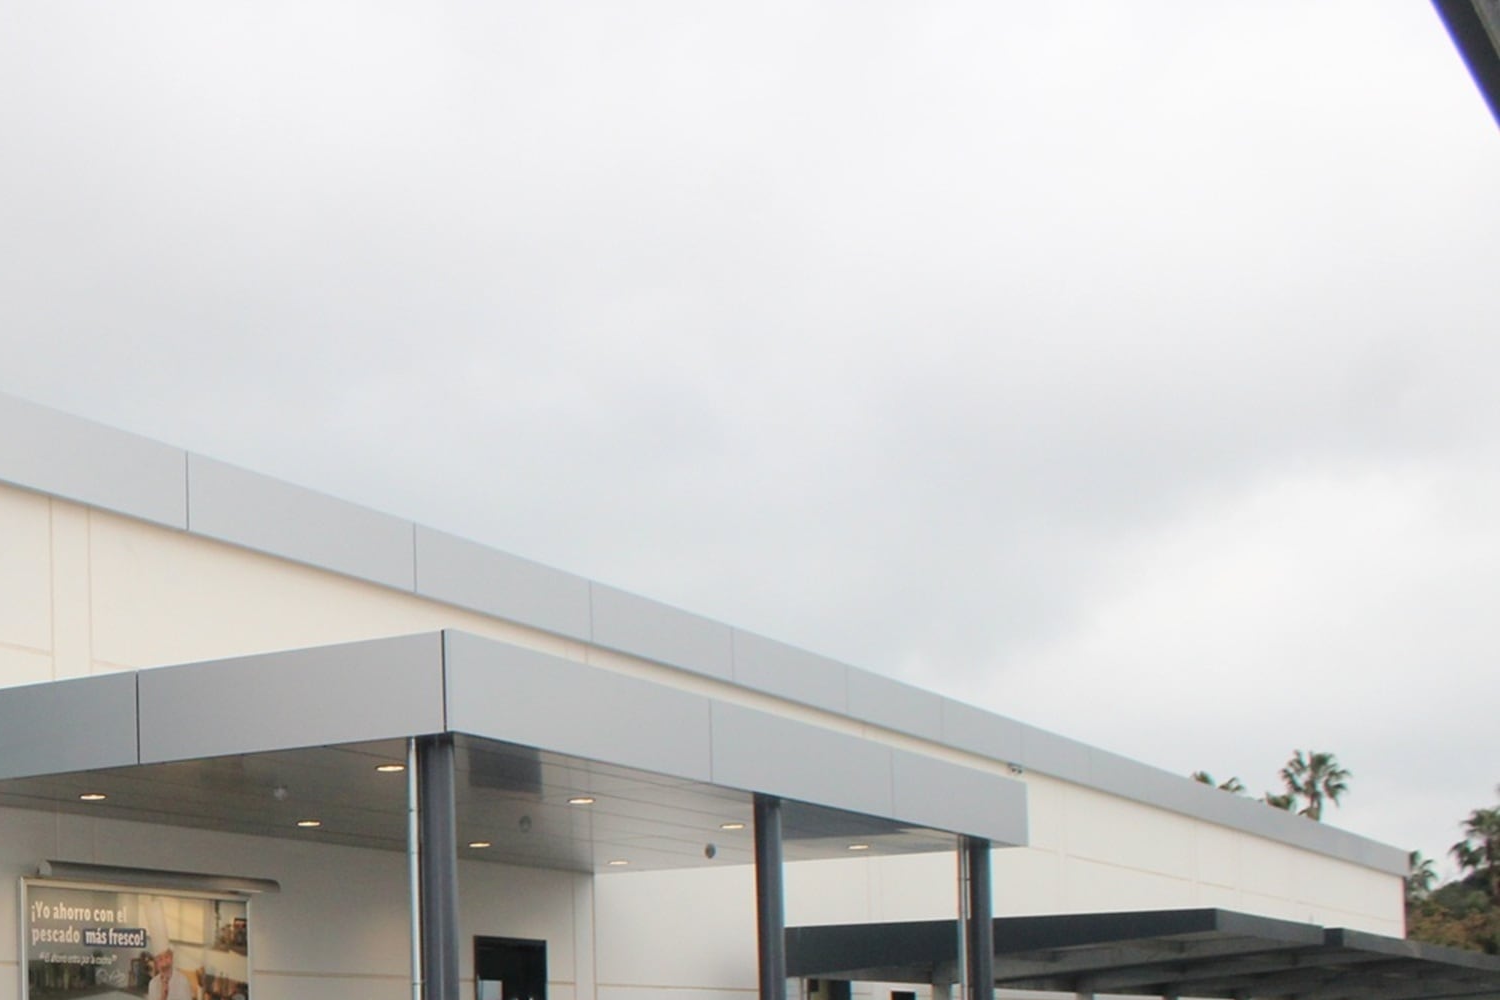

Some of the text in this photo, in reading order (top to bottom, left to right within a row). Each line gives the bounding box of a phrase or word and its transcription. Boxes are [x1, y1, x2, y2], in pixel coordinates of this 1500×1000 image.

[53, 902, 91, 921] ahorro
[93, 908, 114, 922] con
[117, 906, 127, 923] el
[31, 926, 144, 946] pescado más fresco!
